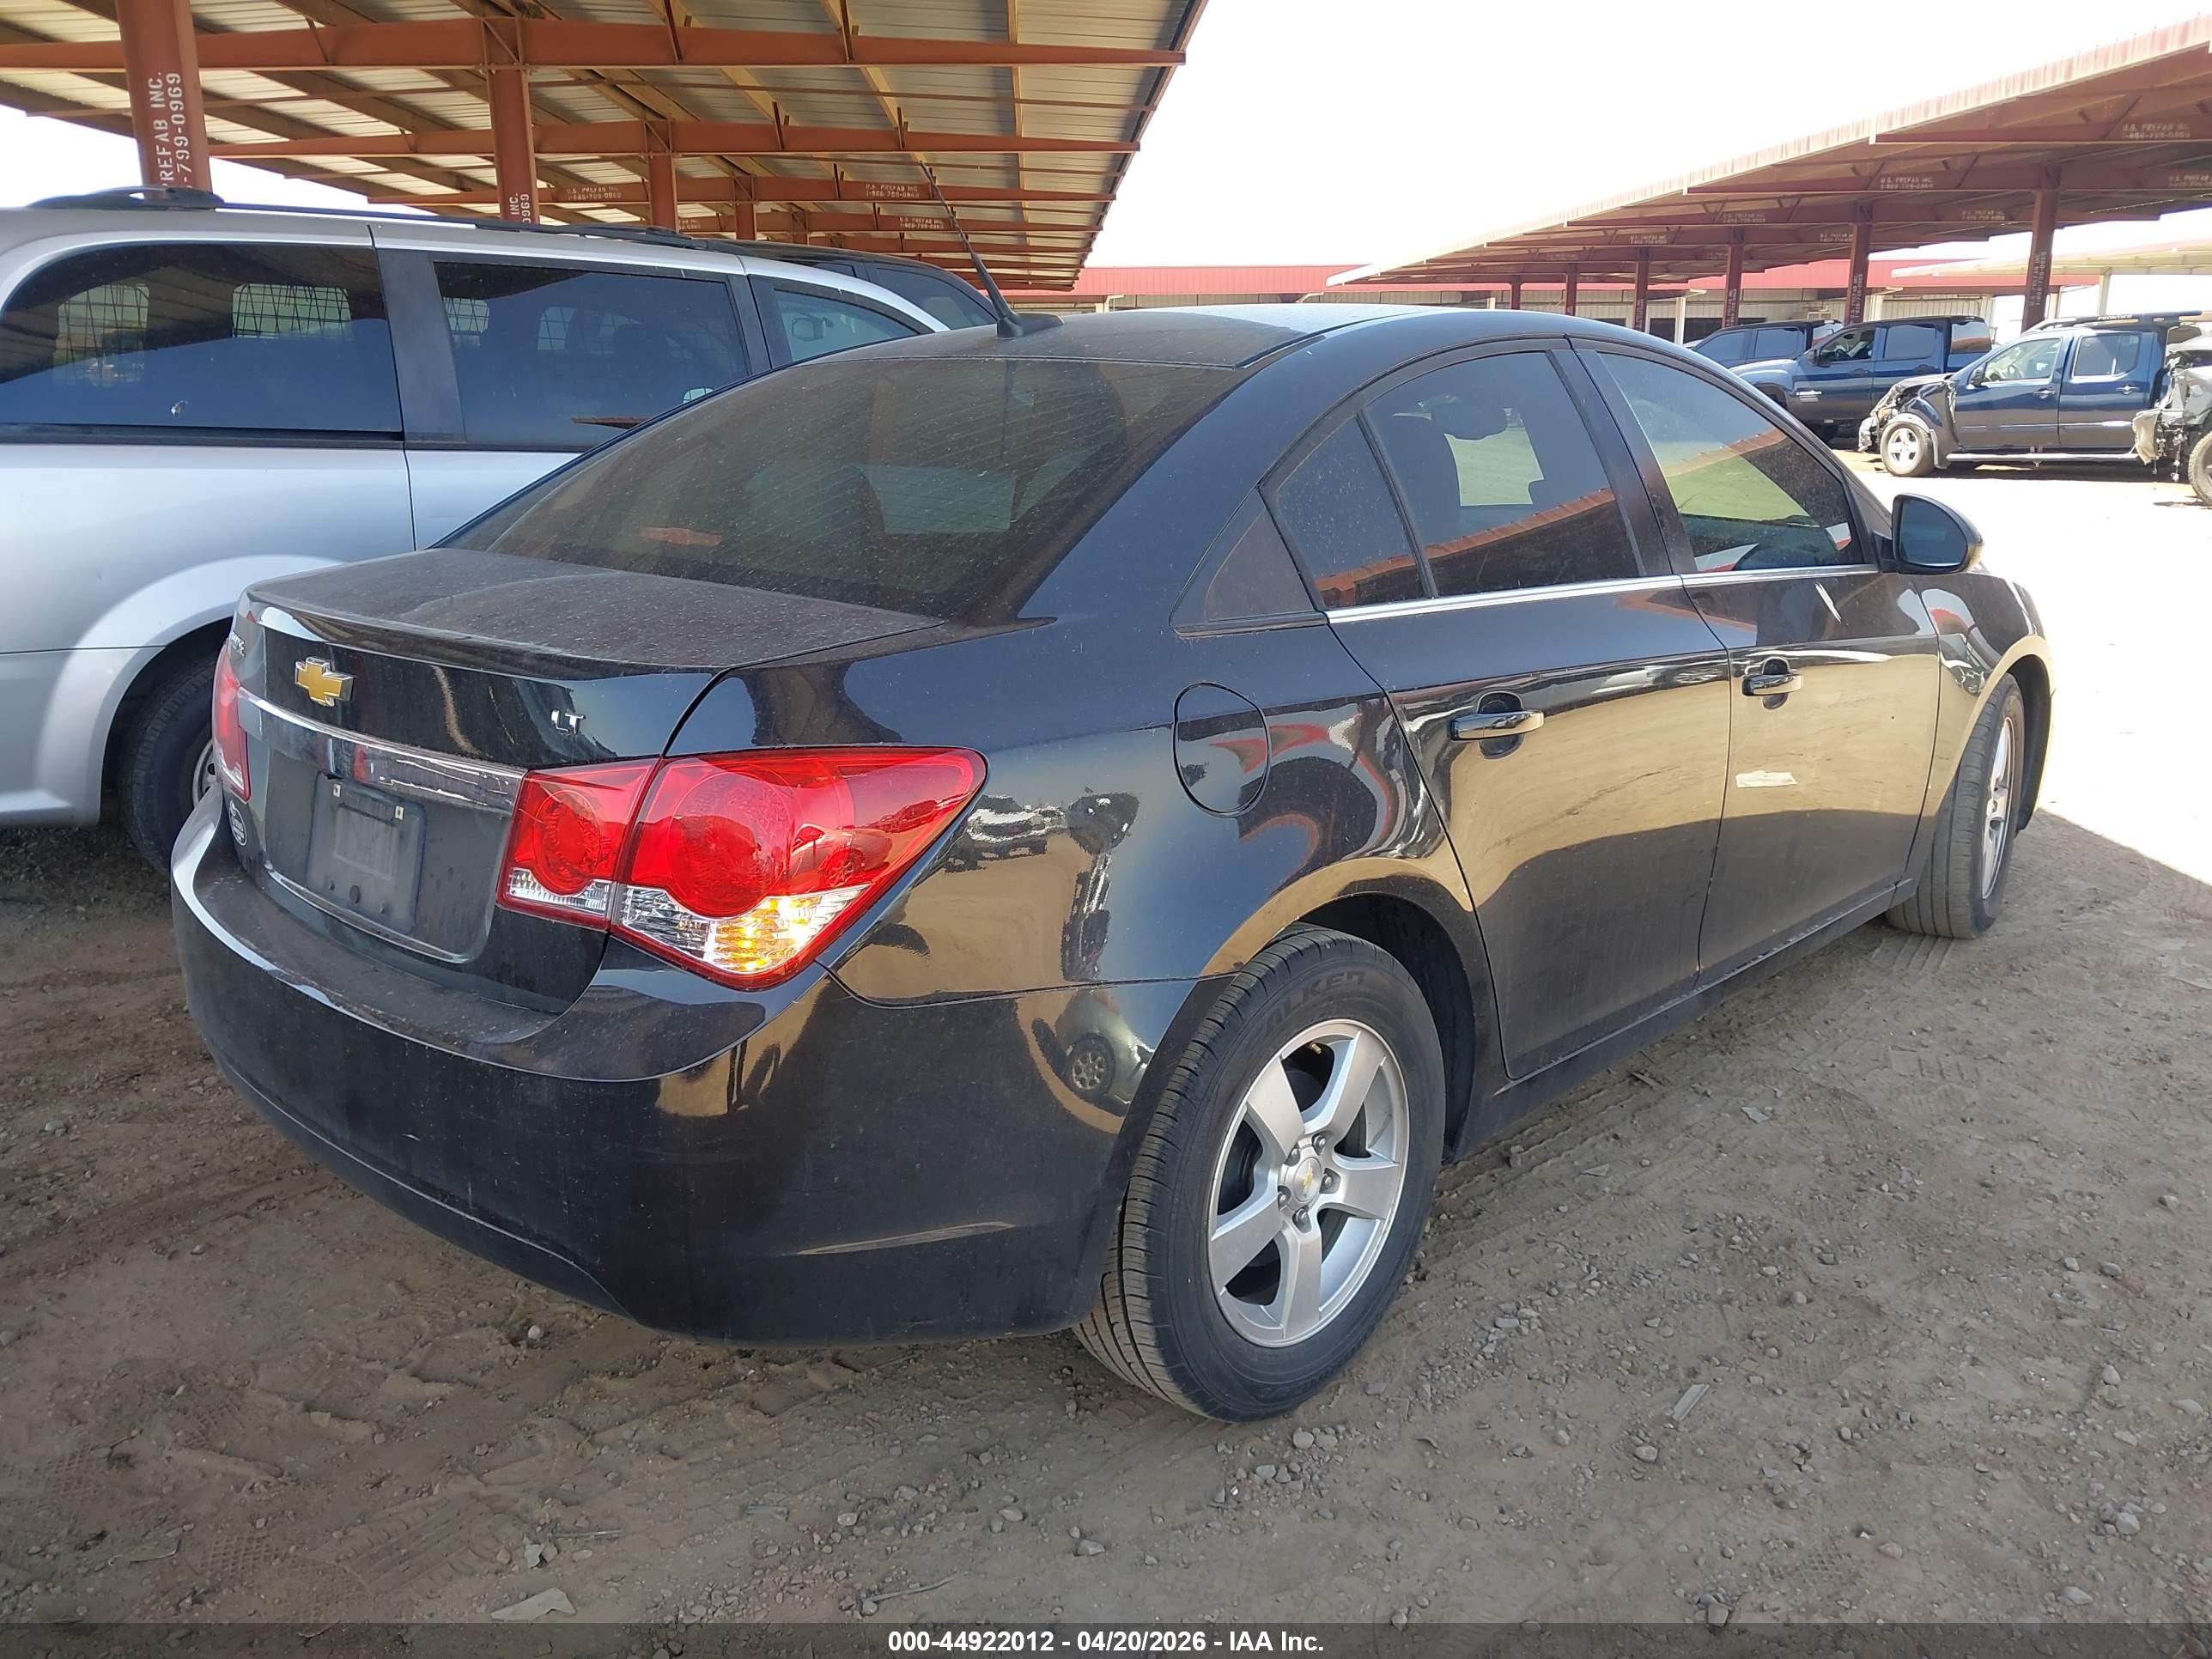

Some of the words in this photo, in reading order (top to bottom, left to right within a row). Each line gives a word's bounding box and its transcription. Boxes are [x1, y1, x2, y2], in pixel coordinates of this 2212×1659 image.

[148, 71, 166, 108] INC.
[166, 72, 193, 188] -799-0969
[153, 118, 174, 186] REFAB
[508, 192, 520, 215] INC.
[550, 709, 584, 735] LT
